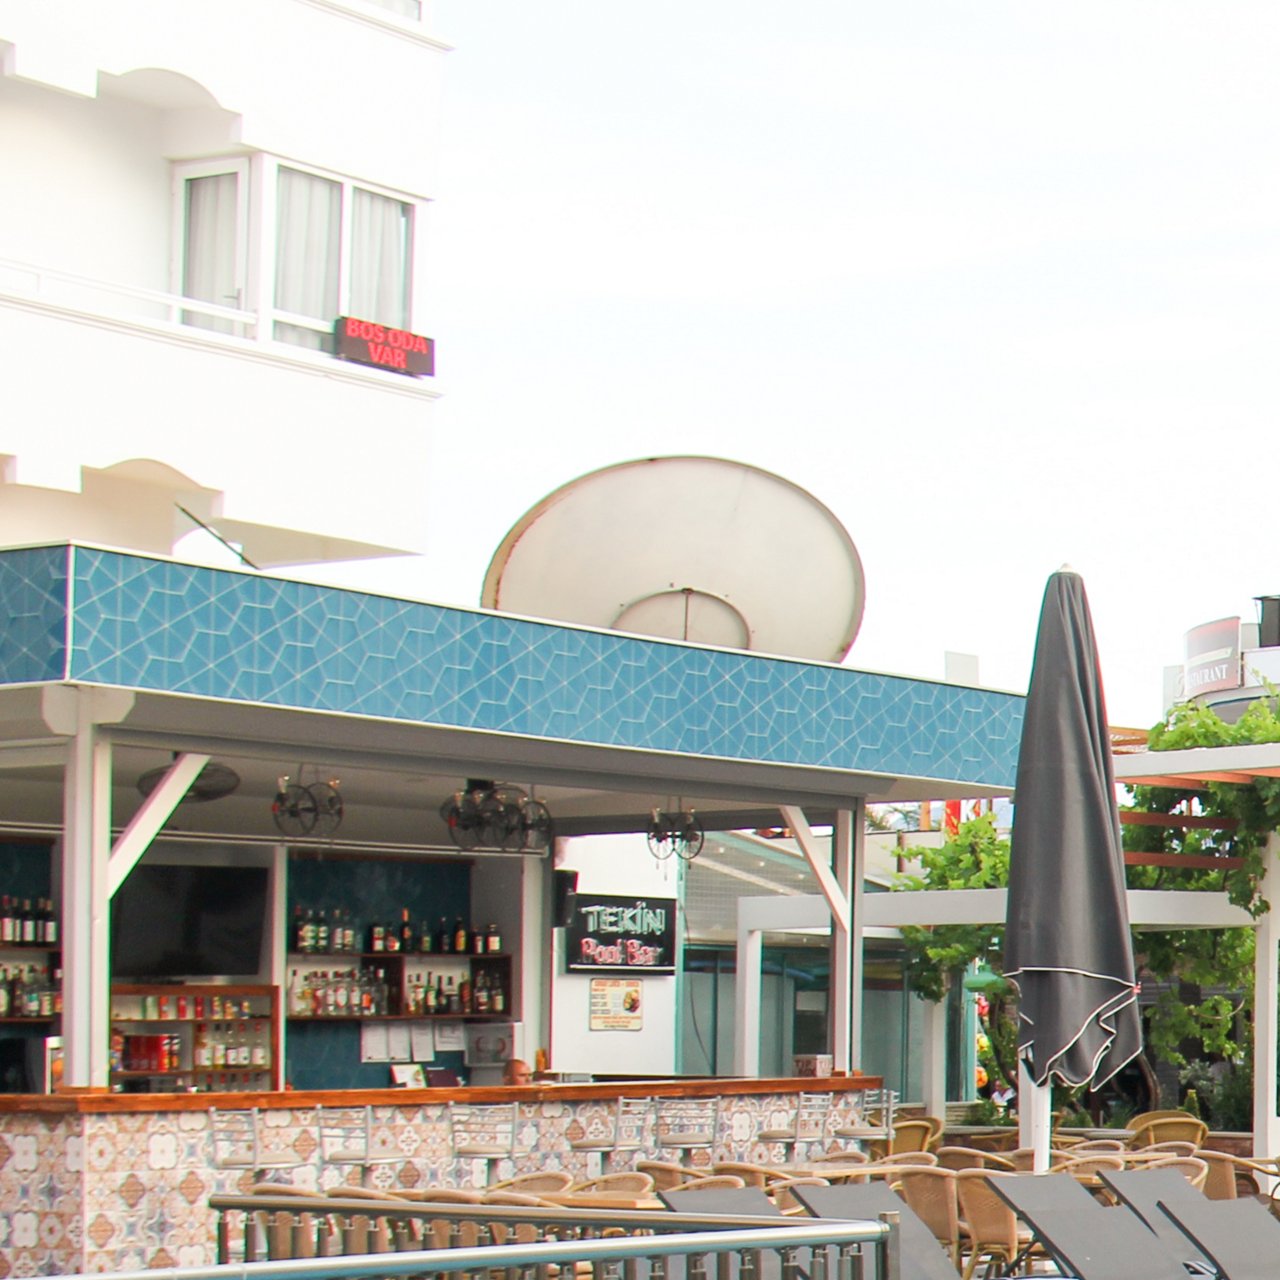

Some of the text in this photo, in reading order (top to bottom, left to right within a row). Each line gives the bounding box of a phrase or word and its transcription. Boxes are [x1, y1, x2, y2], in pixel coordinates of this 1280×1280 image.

[387, 329, 428, 354] ODA
[368, 342, 407, 369] VAR
[581, 938, 663, 965] Pool Bar
